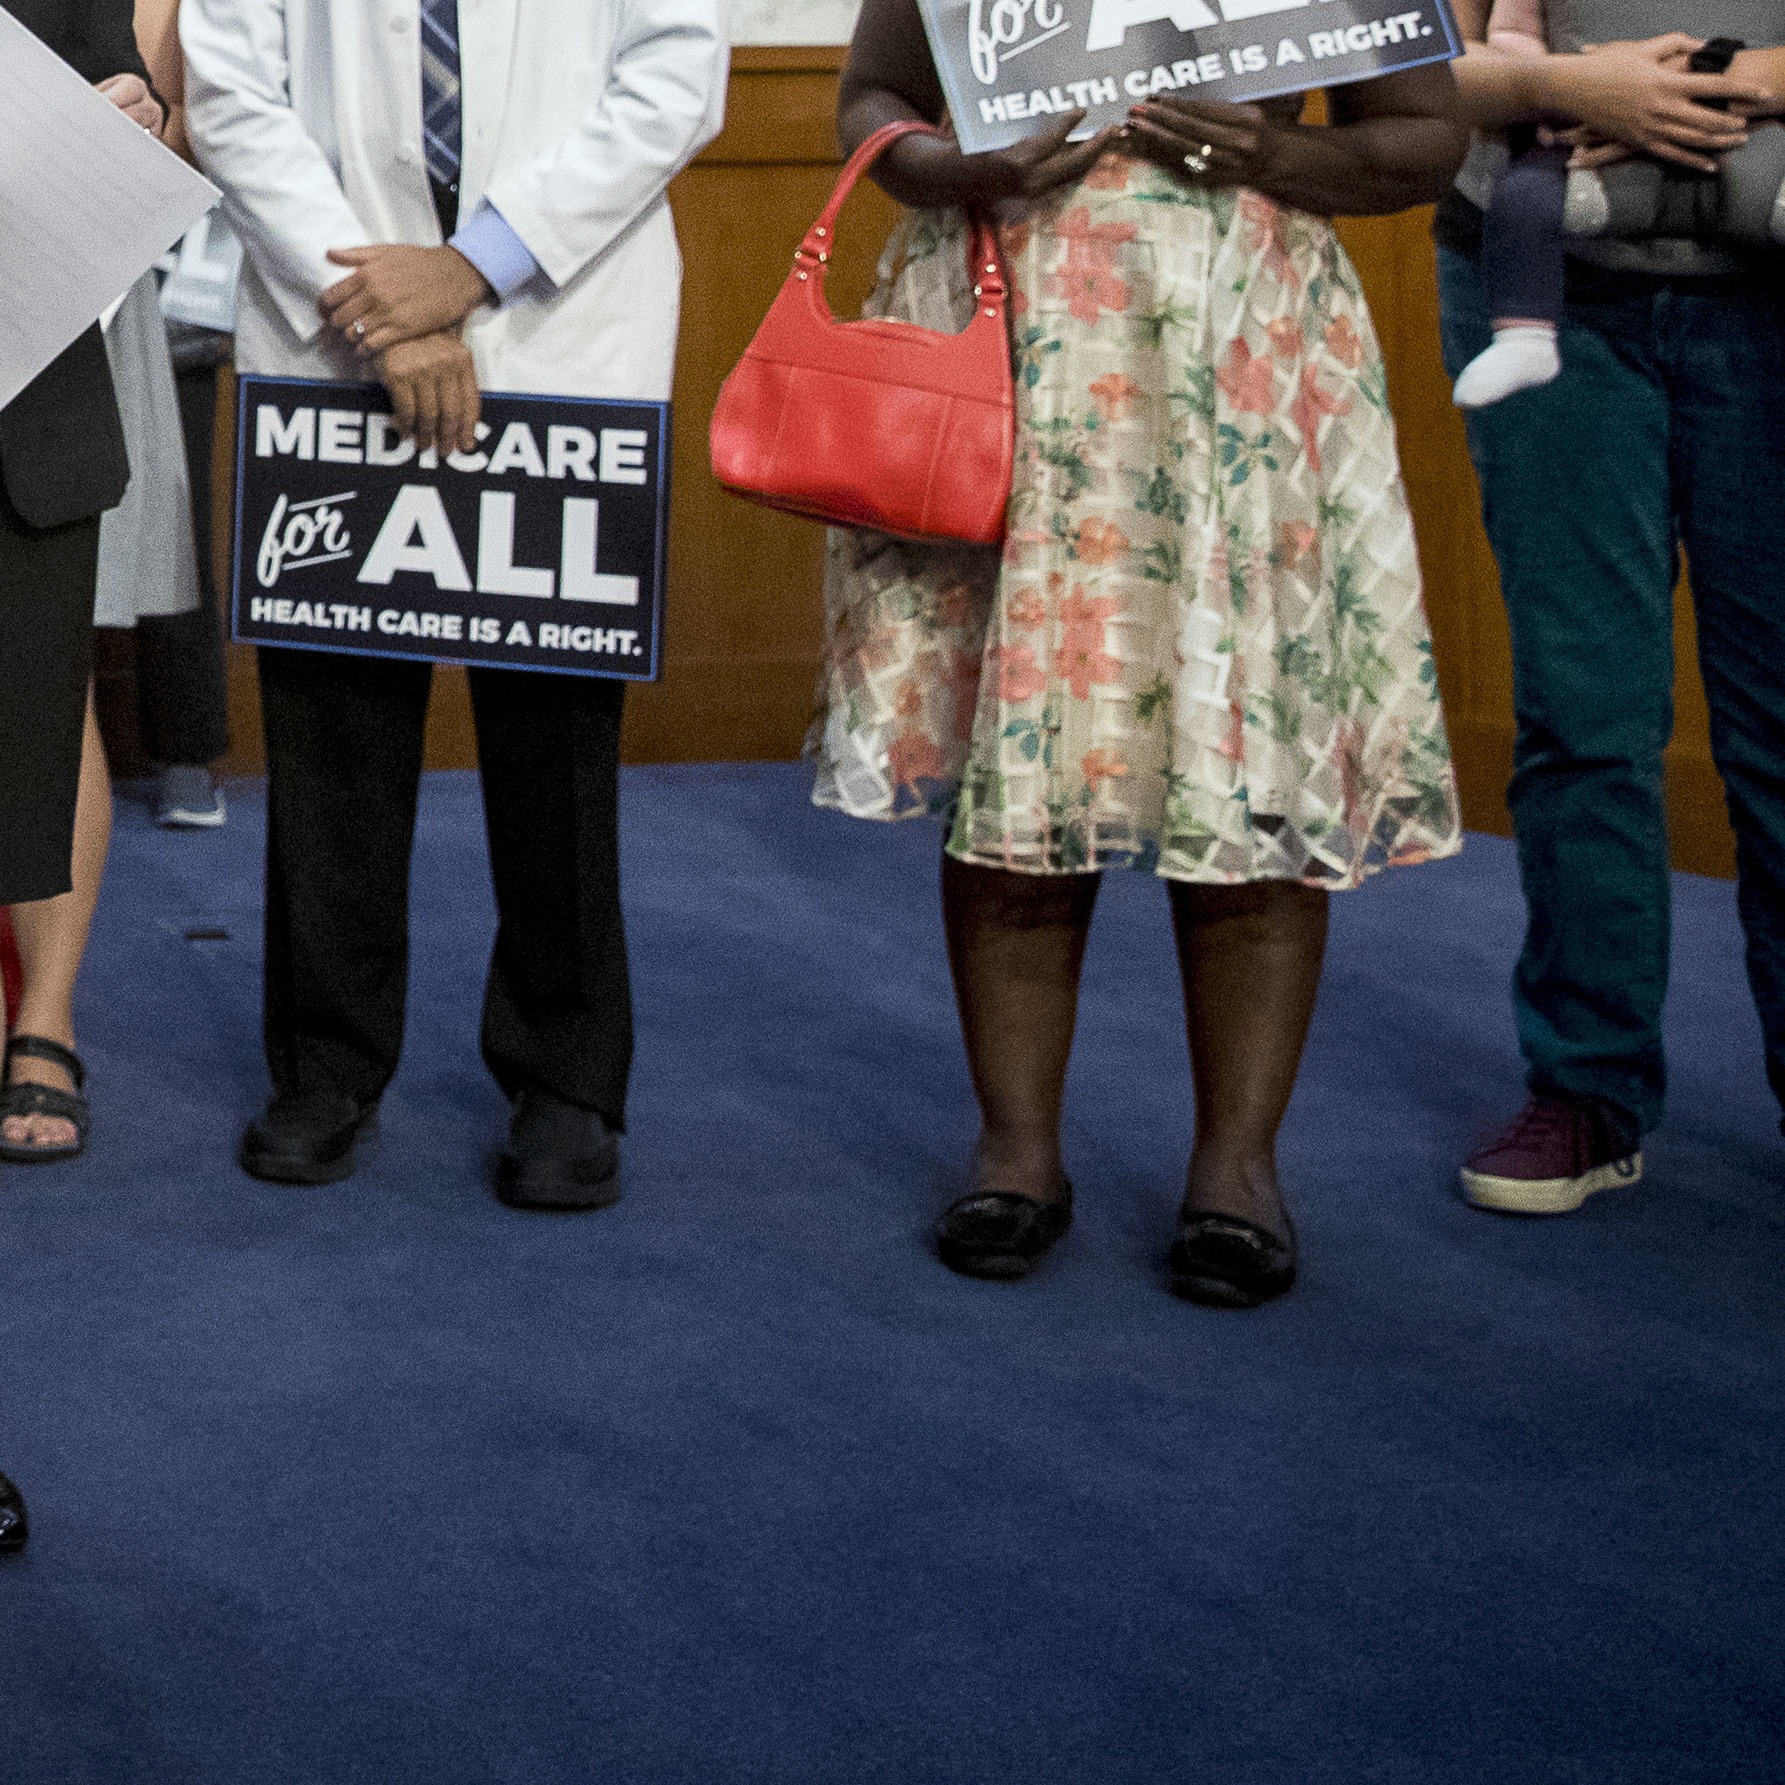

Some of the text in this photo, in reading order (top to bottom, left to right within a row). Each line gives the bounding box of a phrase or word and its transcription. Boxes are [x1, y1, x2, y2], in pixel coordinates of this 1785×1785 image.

[978, 11, 1433, 124] HEALTH CARE IS A RIGHT.
[257, 484, 639, 606] for ALL
[250, 597, 643, 658] HEALTH CARE IS A RIGHT.
